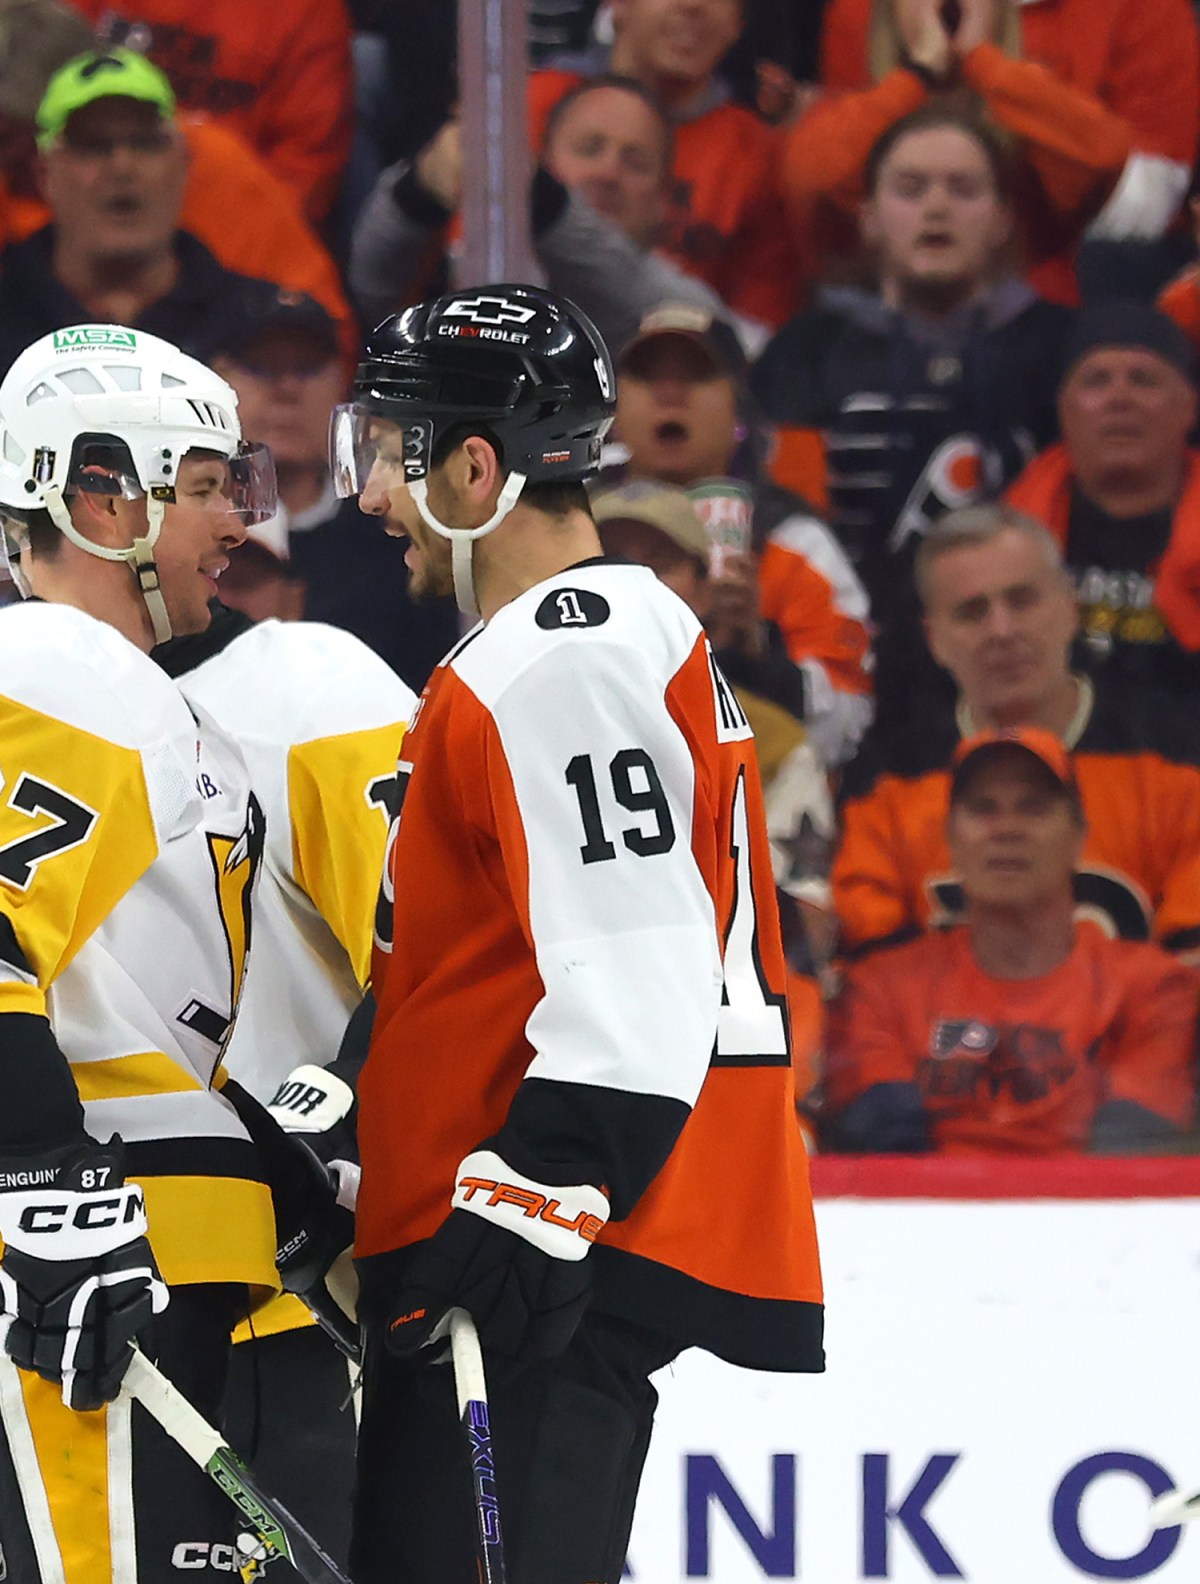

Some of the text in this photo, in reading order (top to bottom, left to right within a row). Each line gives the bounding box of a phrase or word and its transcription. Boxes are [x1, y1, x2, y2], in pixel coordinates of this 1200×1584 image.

[57, 329, 134, 347] MSA
[71, 344, 97, 353] Safety
[438, 326, 530, 345] CHEVROLET
[556, 591, 587, 624] 1
[565, 748, 676, 865] 19
[81, 1167, 111, 1189] 87
[17, 1193, 147, 1234] CCM
[458, 1177, 605, 1243] TRUE
[275, 1229, 307, 1261] CCM
[211, 1465, 278, 1535] CCM
[622, 1452, 966, 1577] NK
